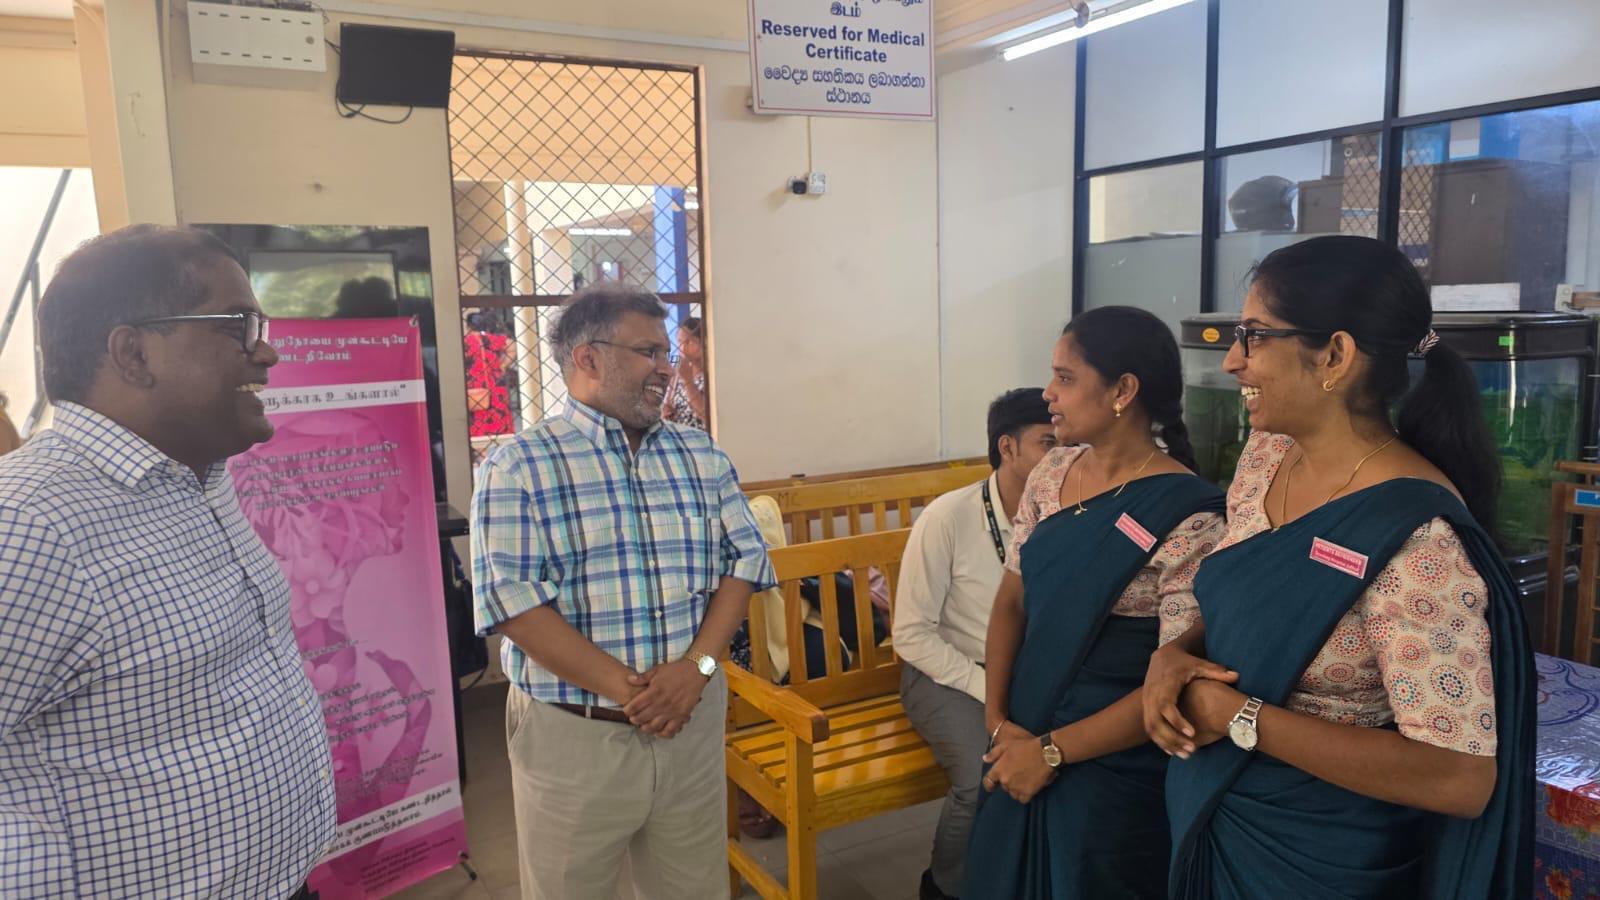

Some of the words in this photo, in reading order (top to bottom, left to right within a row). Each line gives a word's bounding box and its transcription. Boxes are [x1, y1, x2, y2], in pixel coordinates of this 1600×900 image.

[830, 2, 861, 18] இடம்
[761, 19, 837, 40] Reserved
[842, 26, 863, 42] for
[868, 28, 925, 46] Medical
[805, 43, 887, 63] Certificate
[812, 68, 865, 86] සහතිකය
[868, 69, 925, 89] ලබාගන්නා
[826, 89, 871, 105] ස්ථානය
